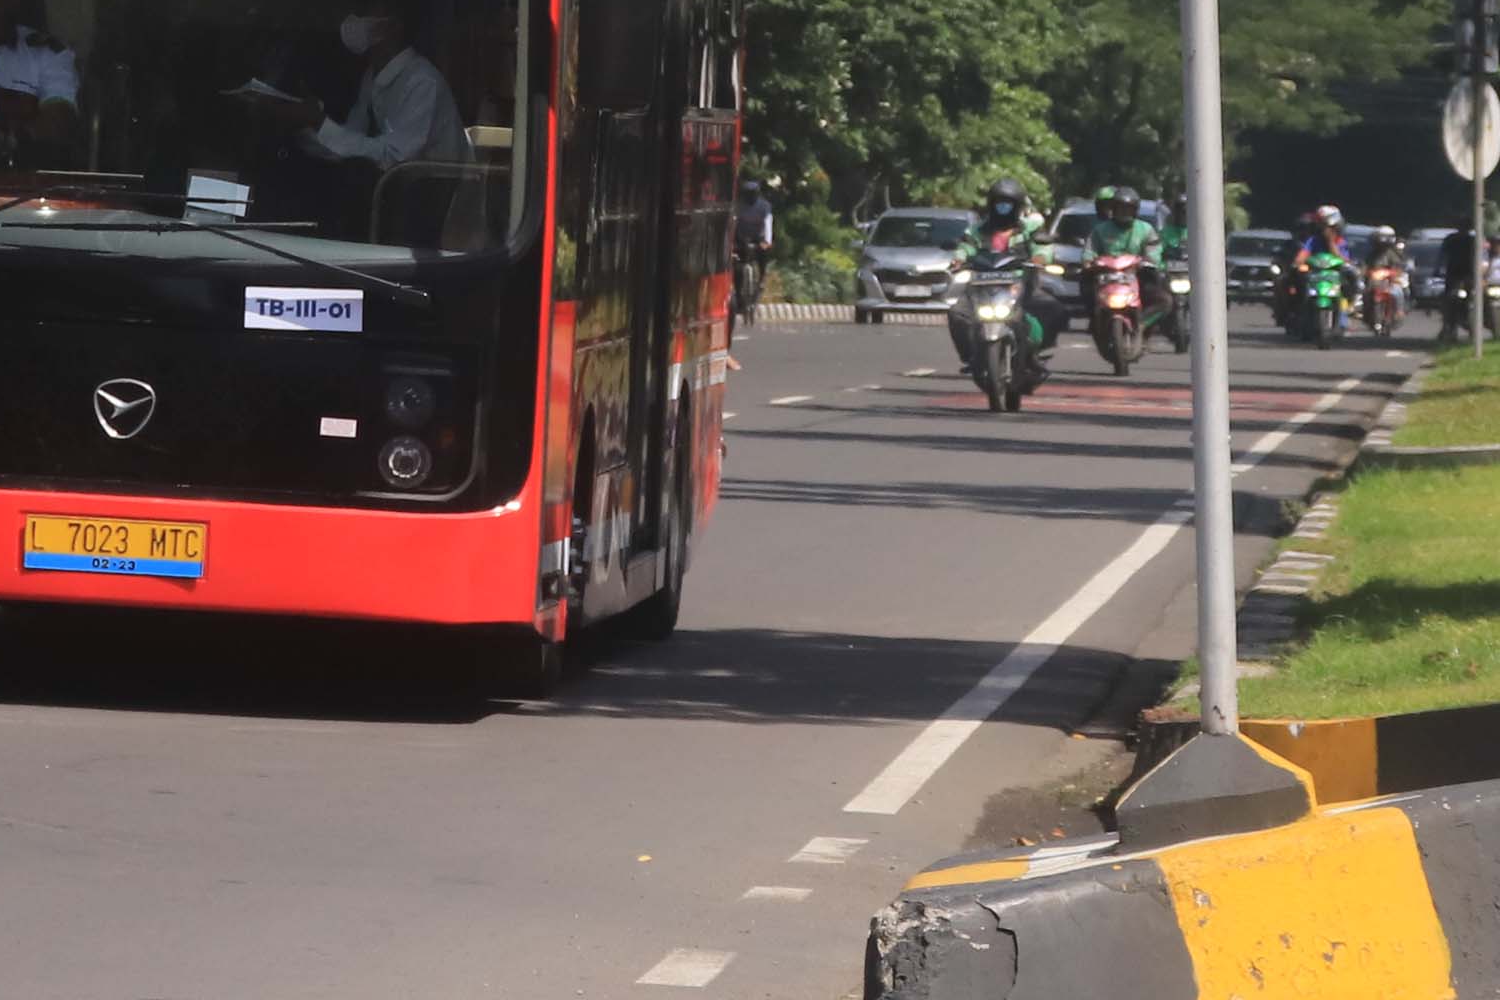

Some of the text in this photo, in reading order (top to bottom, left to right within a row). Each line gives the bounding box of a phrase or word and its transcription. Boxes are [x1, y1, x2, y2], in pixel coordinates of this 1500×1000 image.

[256, 298, 351, 319] TB-III-01
[32, 521, 198, 558] L 7023 MTC
